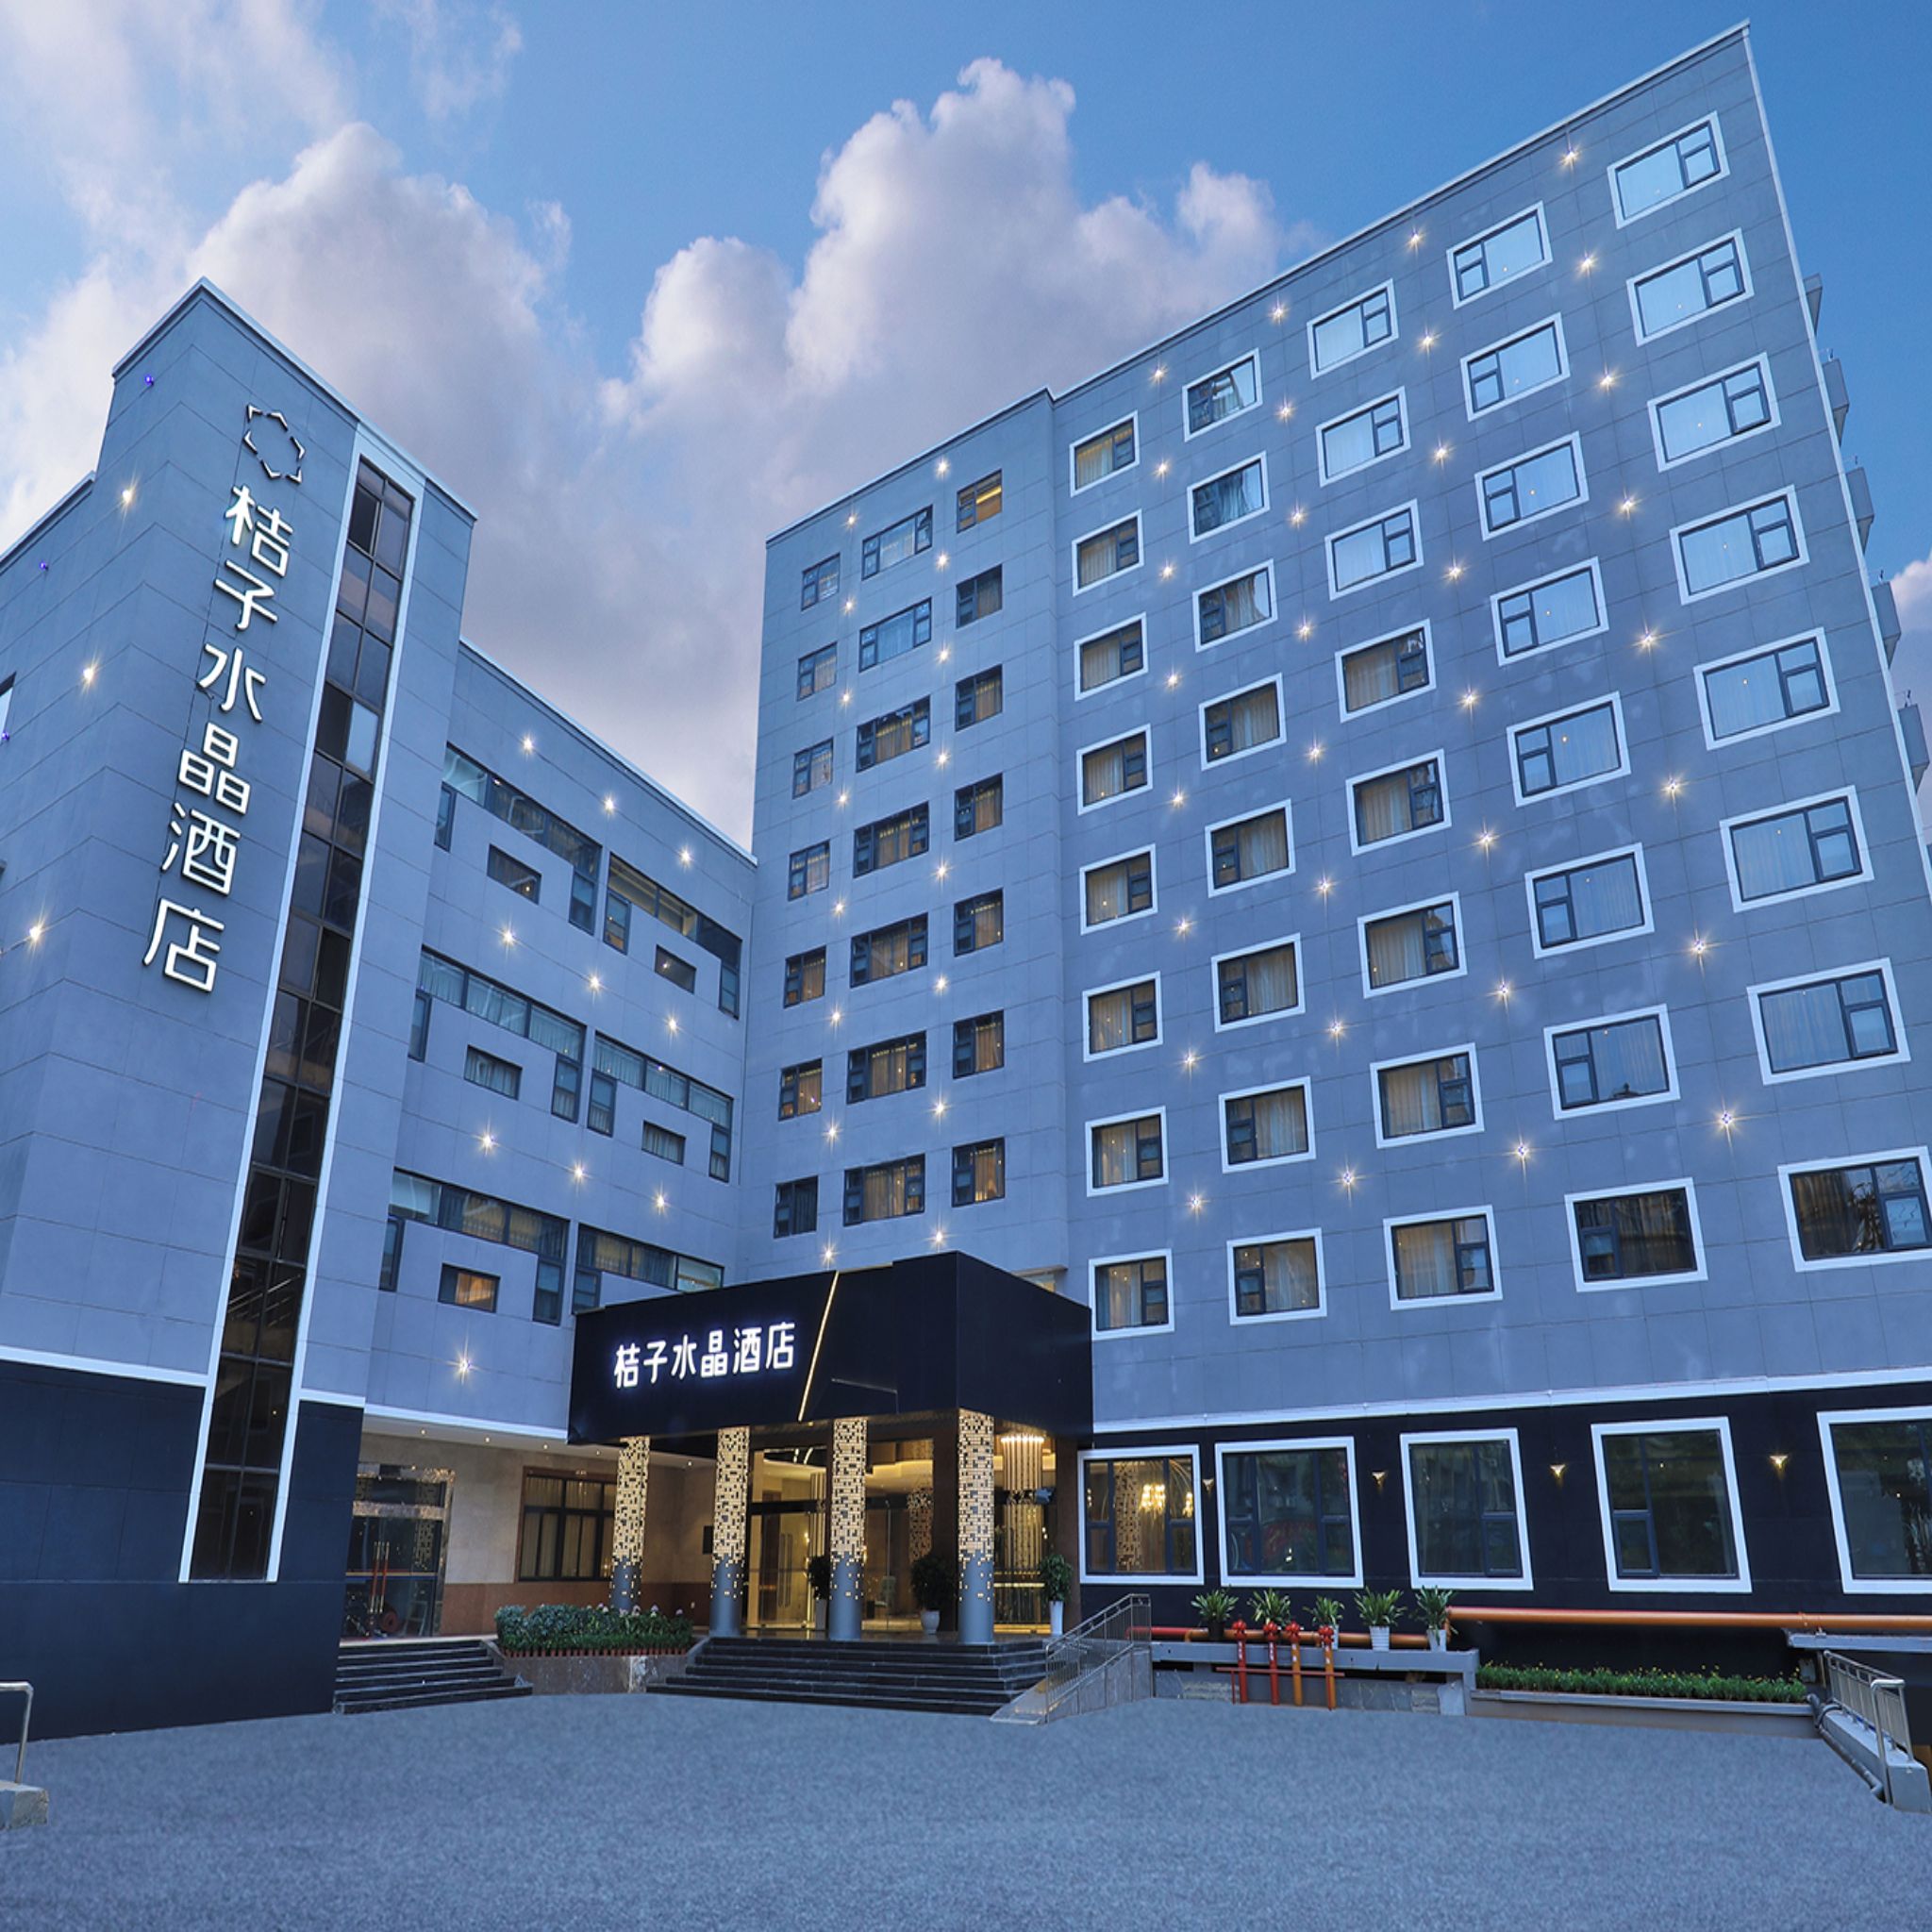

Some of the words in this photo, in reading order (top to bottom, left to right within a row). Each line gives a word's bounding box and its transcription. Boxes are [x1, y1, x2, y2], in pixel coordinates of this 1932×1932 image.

[142, 485, 294, 993] 桔子水晶酒店
[613, 1322, 796, 1390] 桔子水晶酒店
